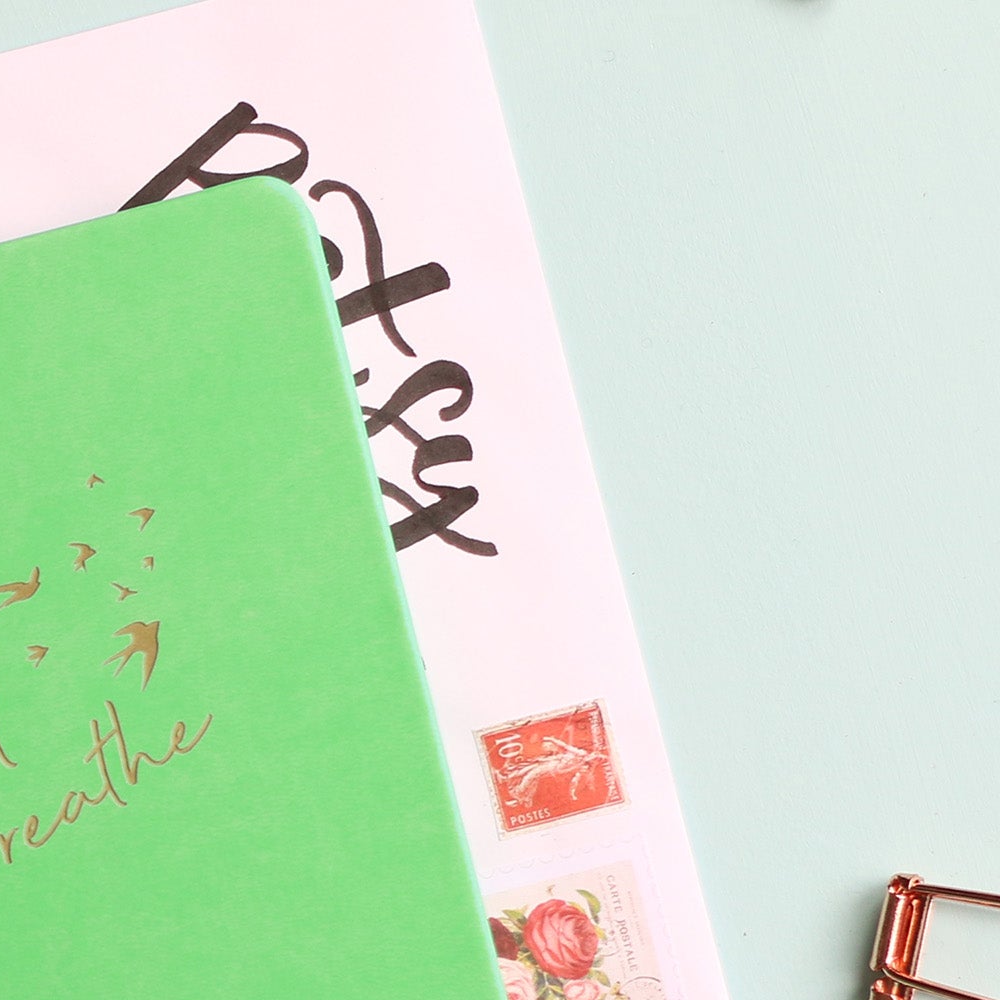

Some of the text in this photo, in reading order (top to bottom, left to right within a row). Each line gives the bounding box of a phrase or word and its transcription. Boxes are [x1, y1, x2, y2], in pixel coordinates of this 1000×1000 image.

[510, 807, 551, 826] POSTES
[606, 874, 623, 913] CARTE
[616, 919, 638, 972] POSTALE
